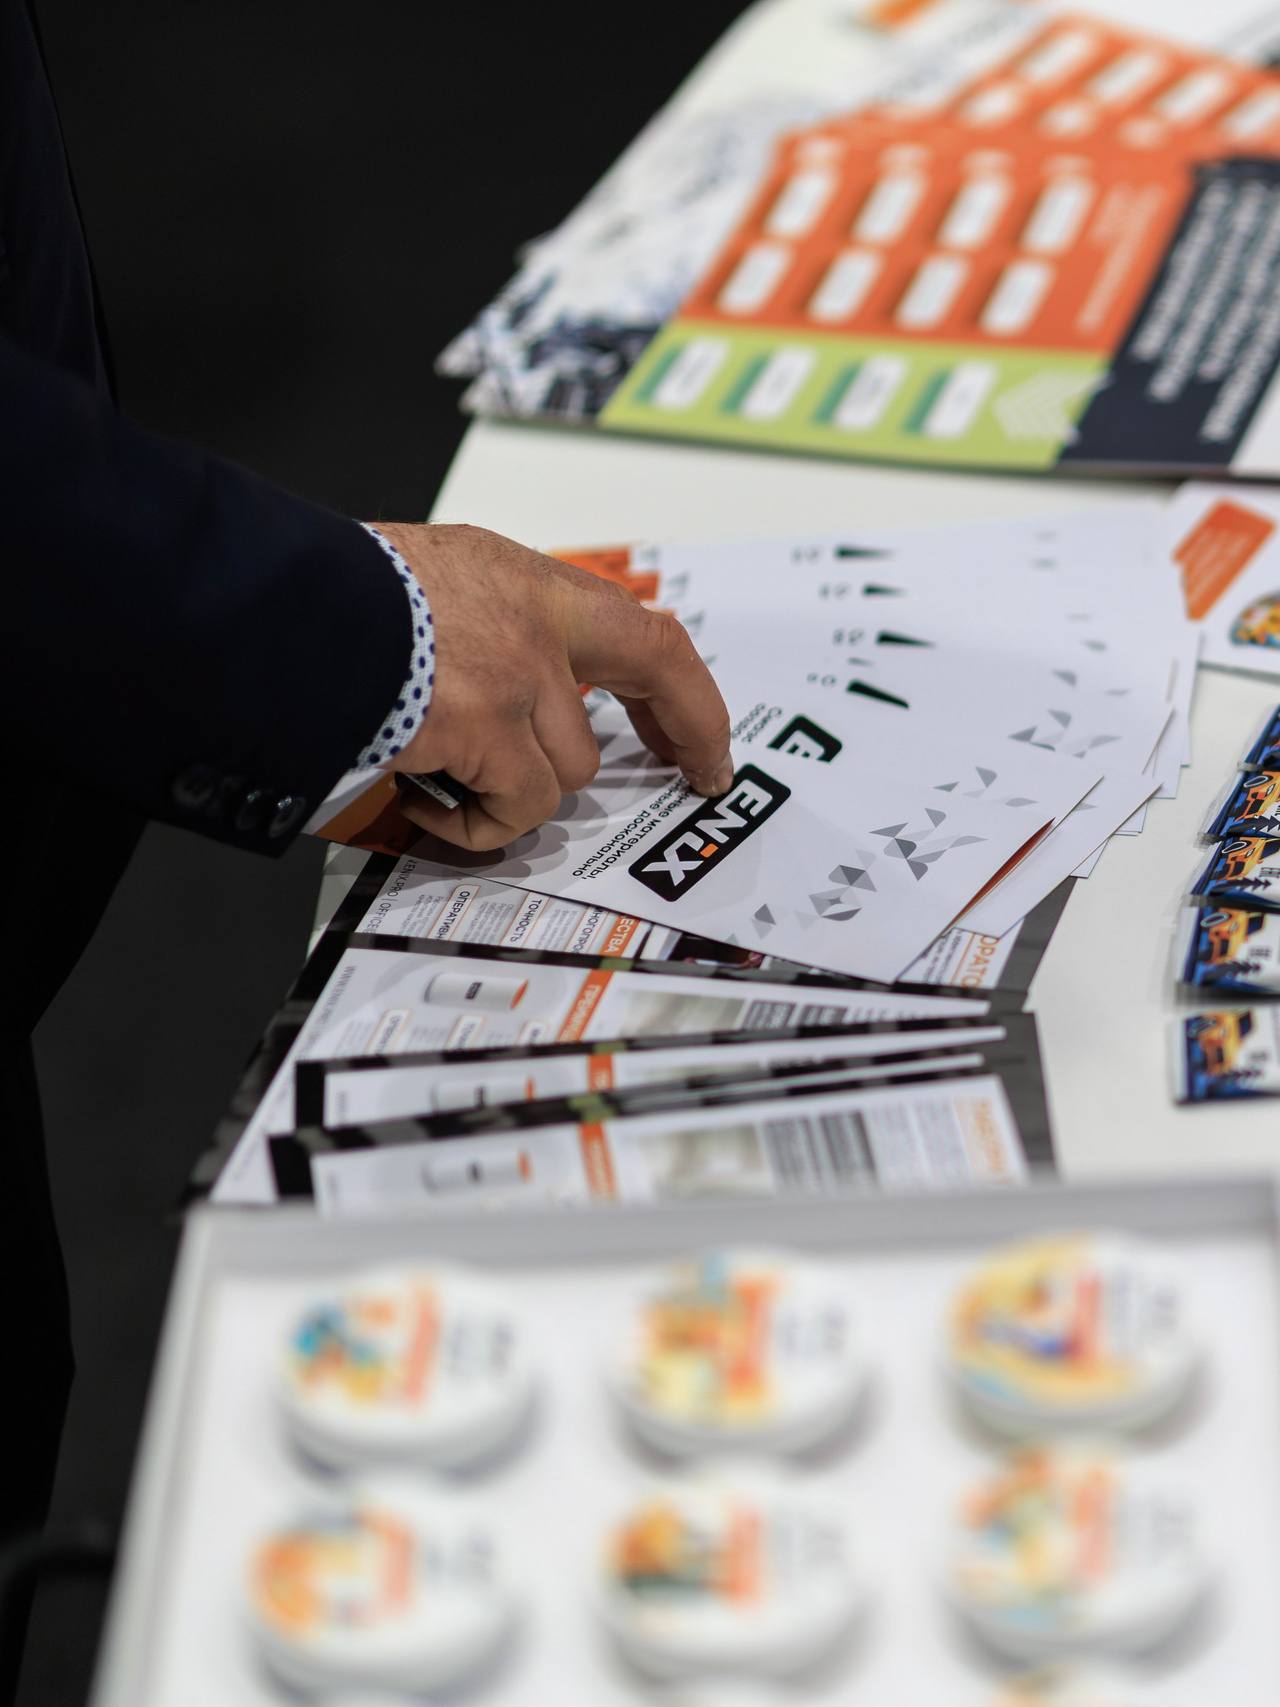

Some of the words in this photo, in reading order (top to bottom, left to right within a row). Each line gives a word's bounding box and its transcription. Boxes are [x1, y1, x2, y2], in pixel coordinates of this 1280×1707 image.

[572, 810, 651, 877] досконально
[581, 816, 661, 880] материалы,
[642, 778, 773, 886] ENIX
[435, 891, 470, 939] ОПЕРАТИВН
[510, 900, 542, 942] ТОЧНОСТЬ
[607, 916, 635, 953] ЕСТВА
[961, 935, 1000, 988] ОРАТО
